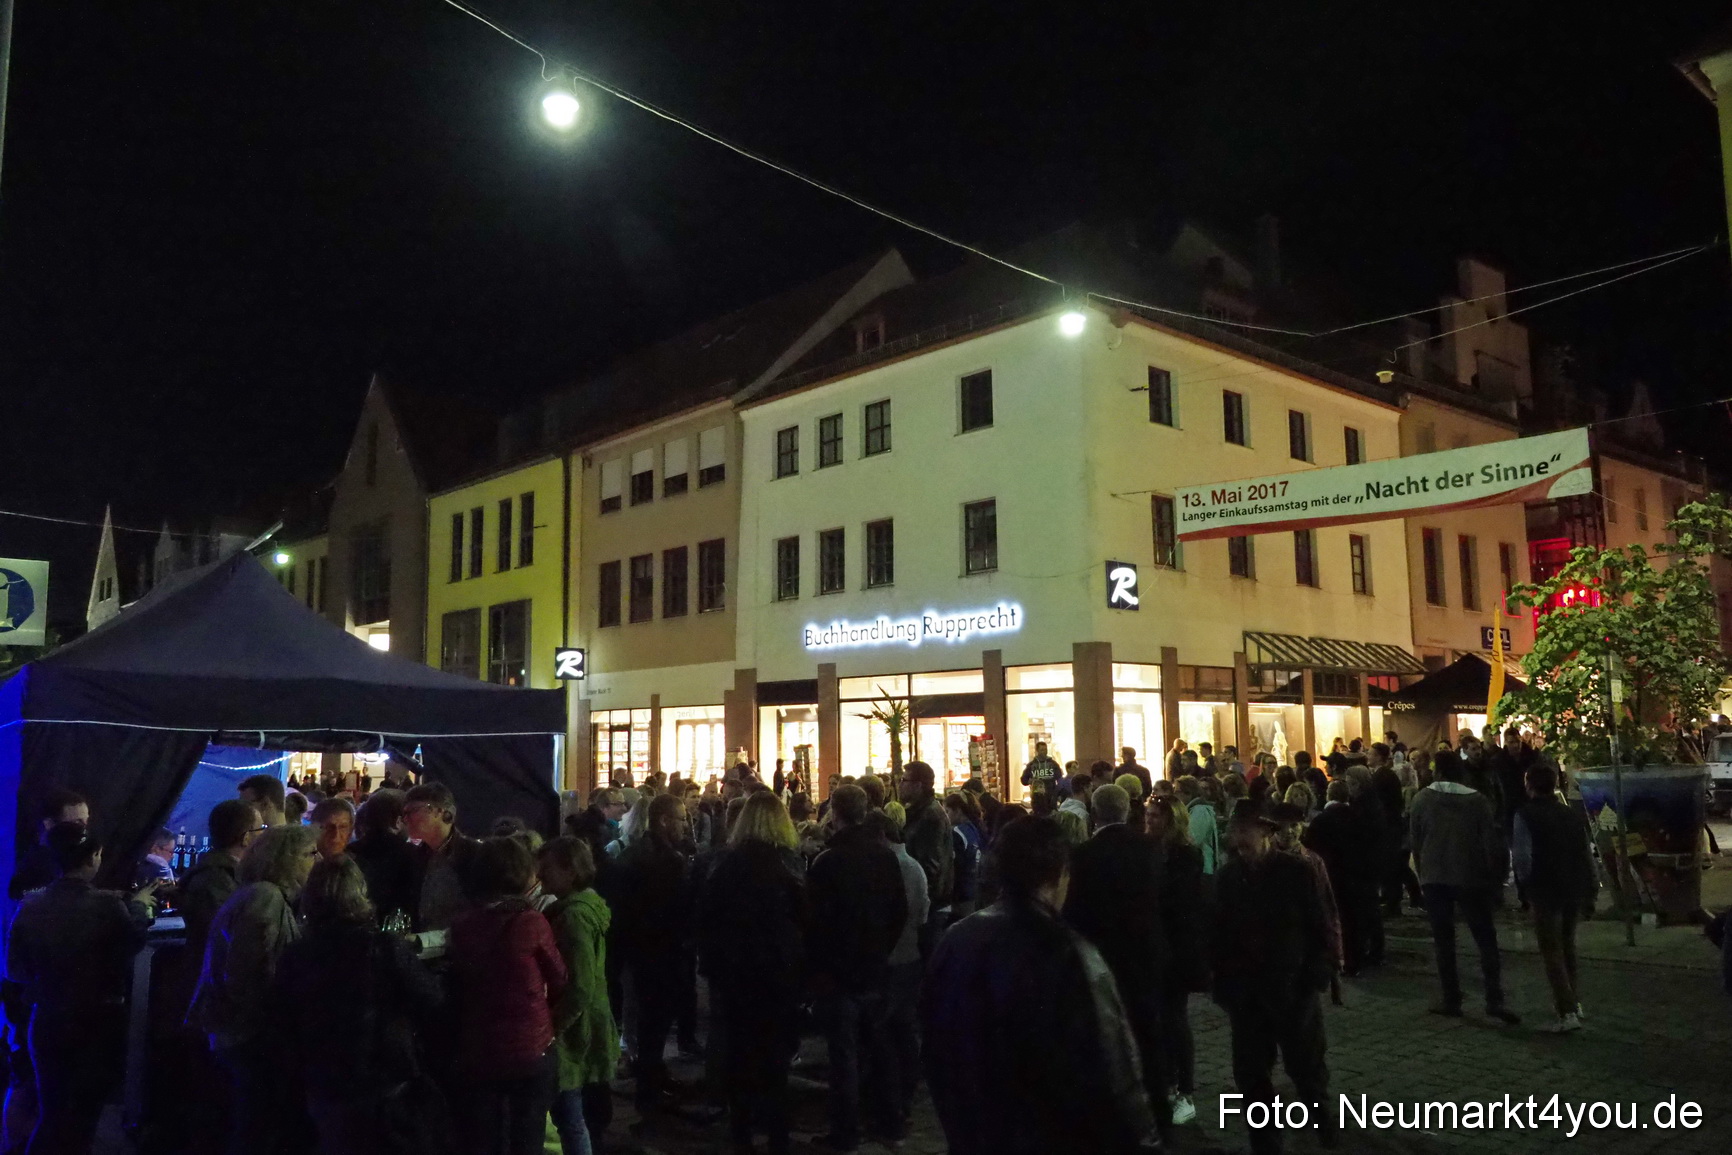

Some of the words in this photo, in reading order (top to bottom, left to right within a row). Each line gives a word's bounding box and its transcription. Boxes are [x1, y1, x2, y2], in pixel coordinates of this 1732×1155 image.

[1182, 493, 1206, 508] 13.
[1211, 487, 1242, 505] Mai
[1247, 481, 1289, 501] 2017
[1182, 512, 1217, 522] Langer
[1219, 500, 1308, 518] Einkaufssamstag
[1311, 496, 1330, 507] mit
[1332, 493, 1352, 506] der
[1435, 470, 1475, 491] der
[1110, 567, 1139, 605] R
[805, 620, 917, 647] Buchhandlung
[923, 607, 1016, 638] Rupprecht
[1487, 628, 1510, 643] CIL
[556, 651, 584, 678] R
[1387, 701, 1416, 711] Crêpes
[1031, 768, 1055, 778] VIBES
